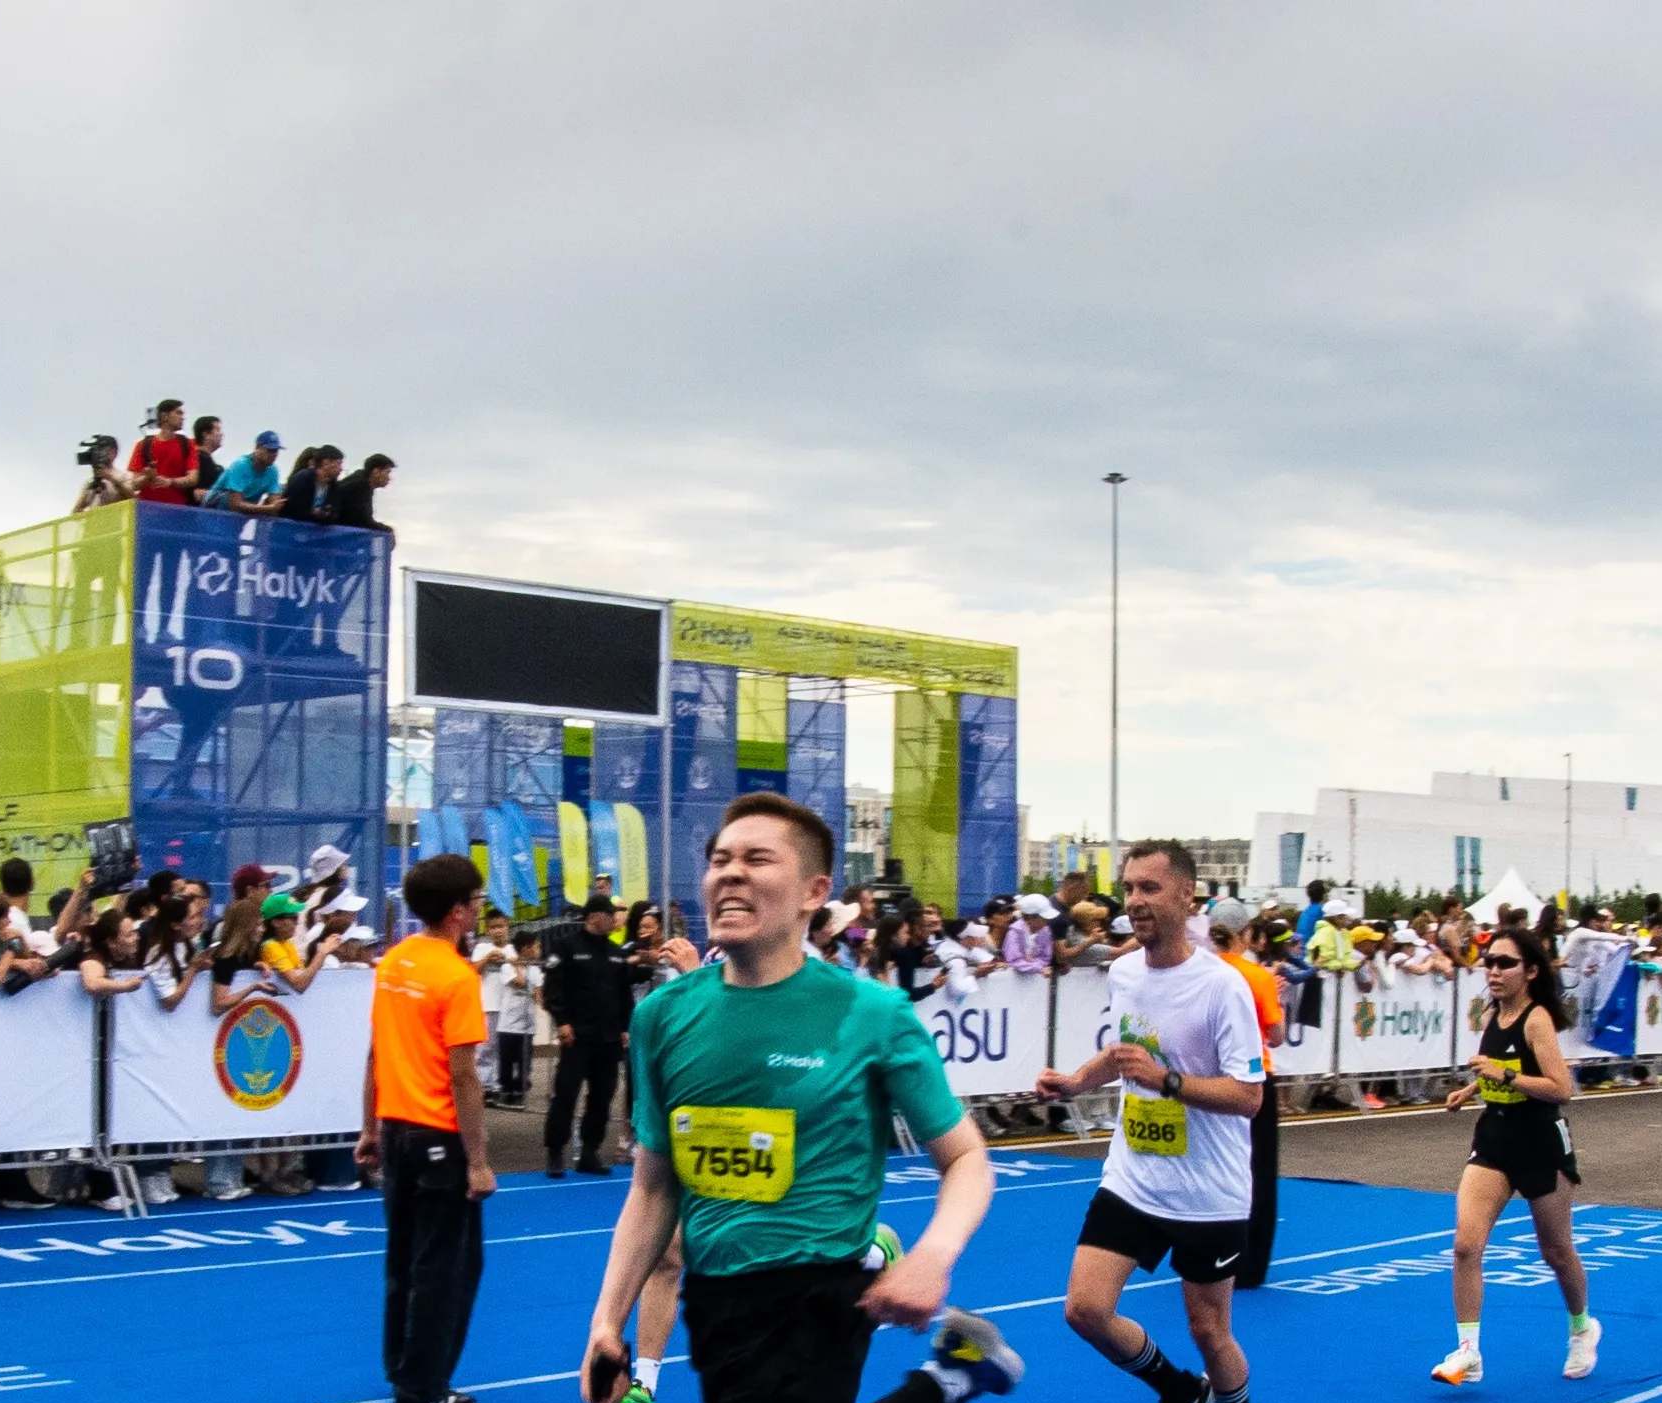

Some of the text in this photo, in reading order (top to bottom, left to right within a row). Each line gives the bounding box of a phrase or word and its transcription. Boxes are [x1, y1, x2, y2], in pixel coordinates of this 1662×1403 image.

[237, 558, 336, 609] Halyk
[165, 645, 244, 690] 10
[932, 1007, 1009, 1064] asu
[1379, 1000, 1445, 1043] Halyk
[1127, 1117, 1177, 1144] 3286
[689, 1145, 777, 1180] 7554
